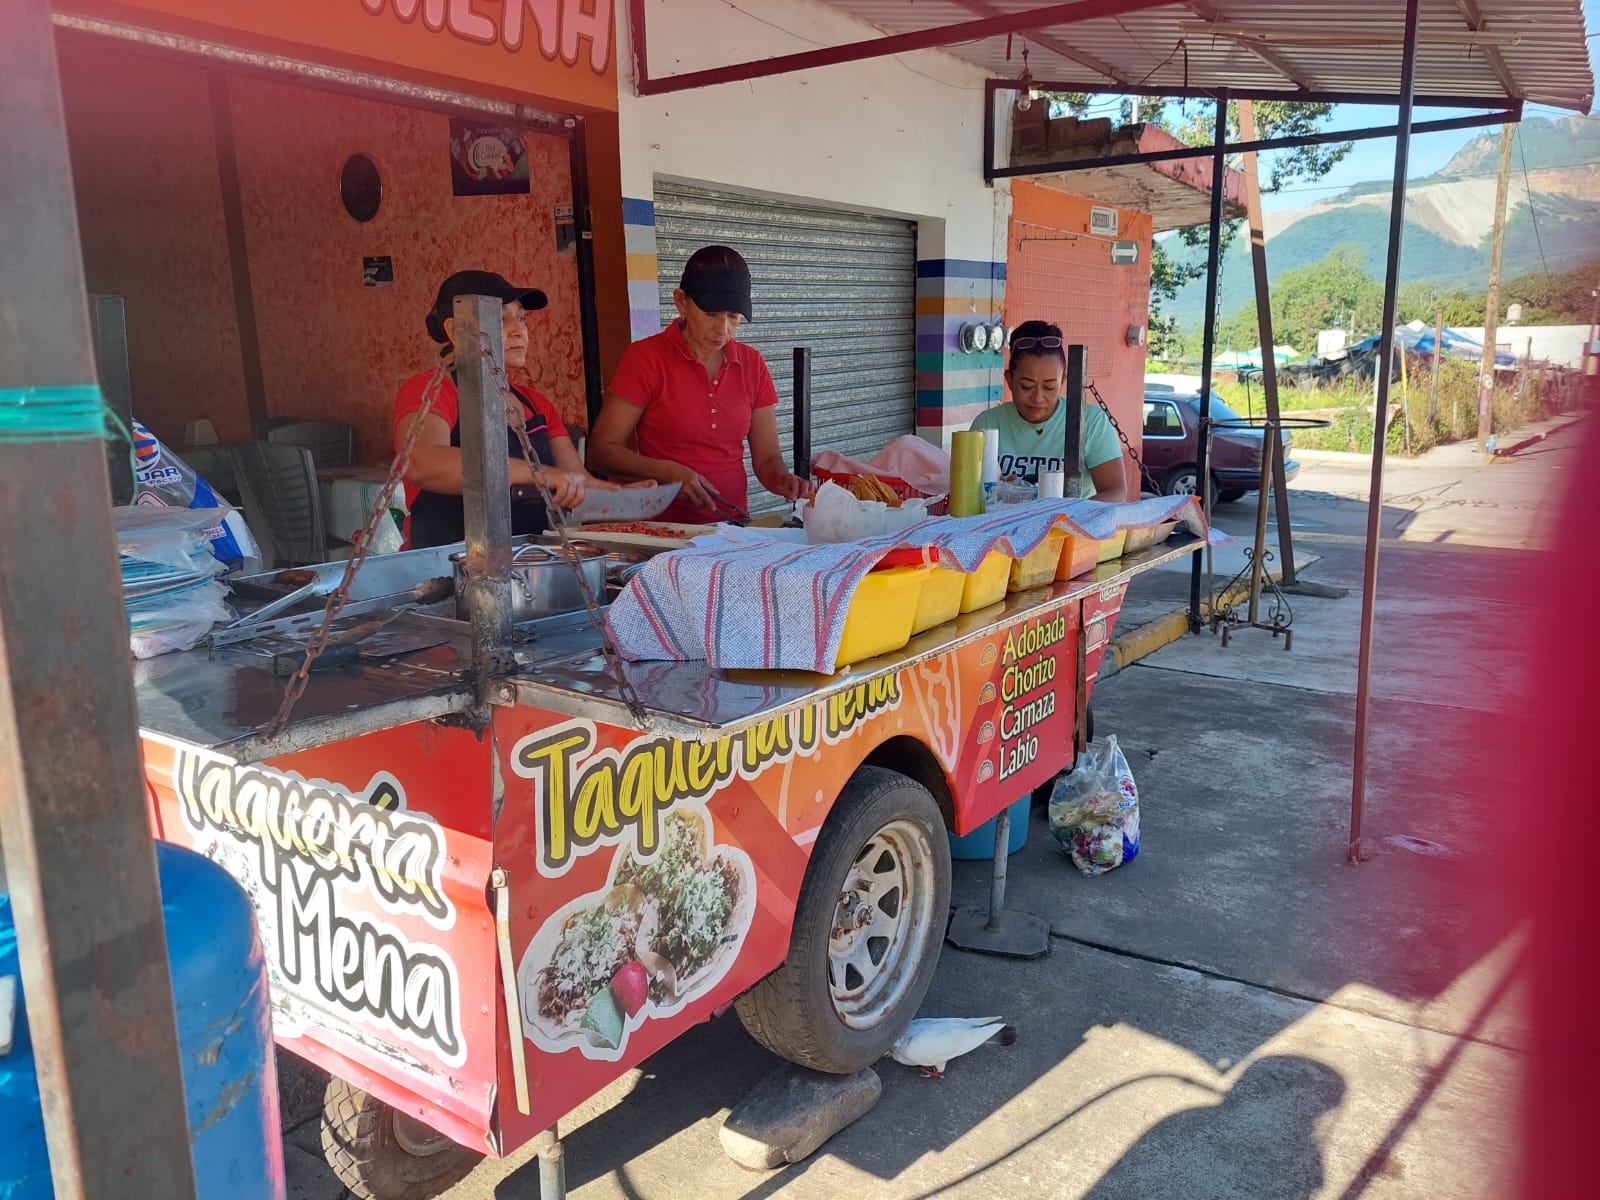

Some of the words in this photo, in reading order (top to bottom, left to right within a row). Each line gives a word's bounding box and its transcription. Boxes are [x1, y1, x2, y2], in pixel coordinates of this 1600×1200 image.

[361, 0, 612, 73] ENA
[998, 455, 1064, 480] OSTO
[1002, 611, 1065, 665] Adobada
[1001, 654, 1056, 702] Chorizo
[1000, 691, 1055, 741] Carnaza
[999, 734, 1039, 781] Labio
[279, 862, 457, 1053] Mena
